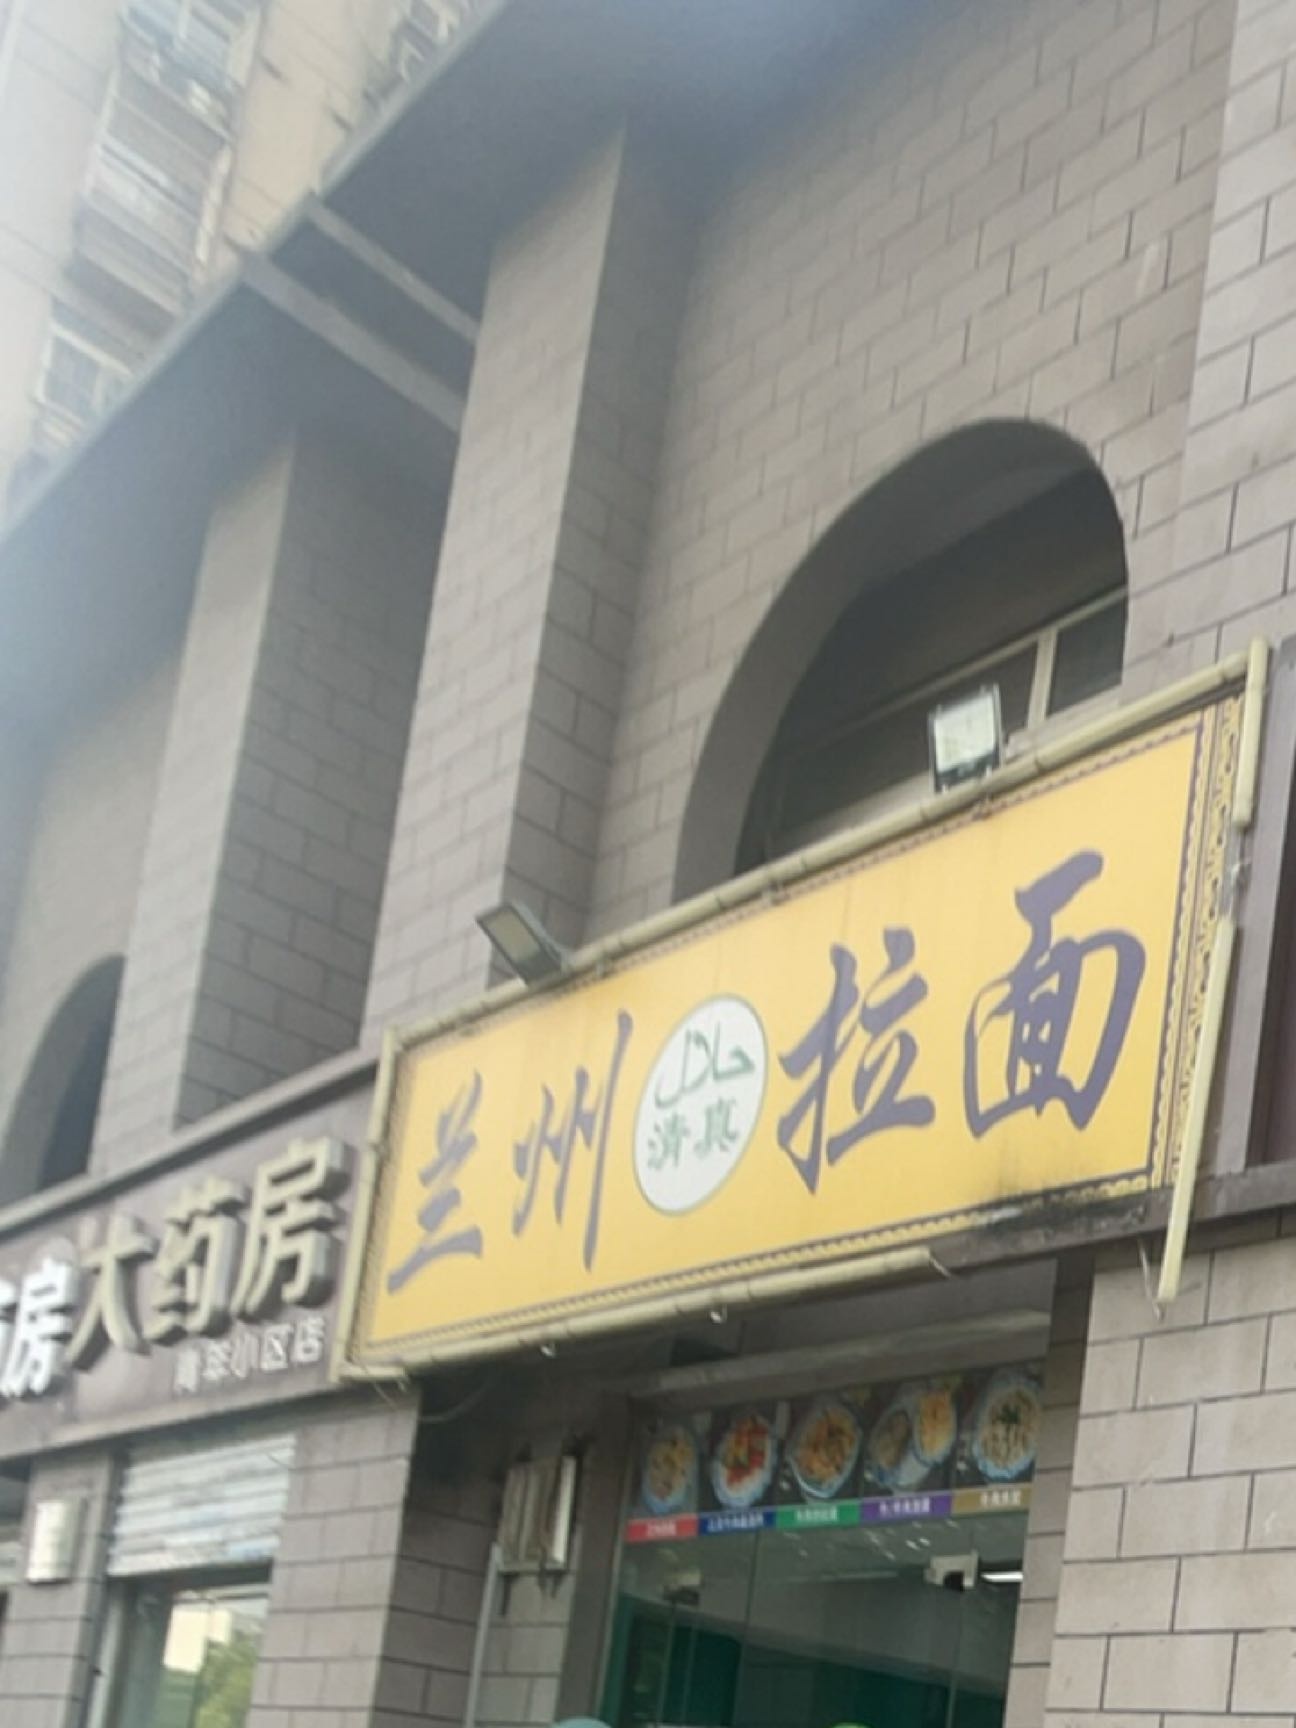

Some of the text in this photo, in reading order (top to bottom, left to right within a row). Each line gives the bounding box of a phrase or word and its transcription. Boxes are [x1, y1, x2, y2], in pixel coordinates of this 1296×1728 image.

[387, 849, 1145, 1294] 兰州 拉面
[0, 1136, 348, 1396] 房大药房
